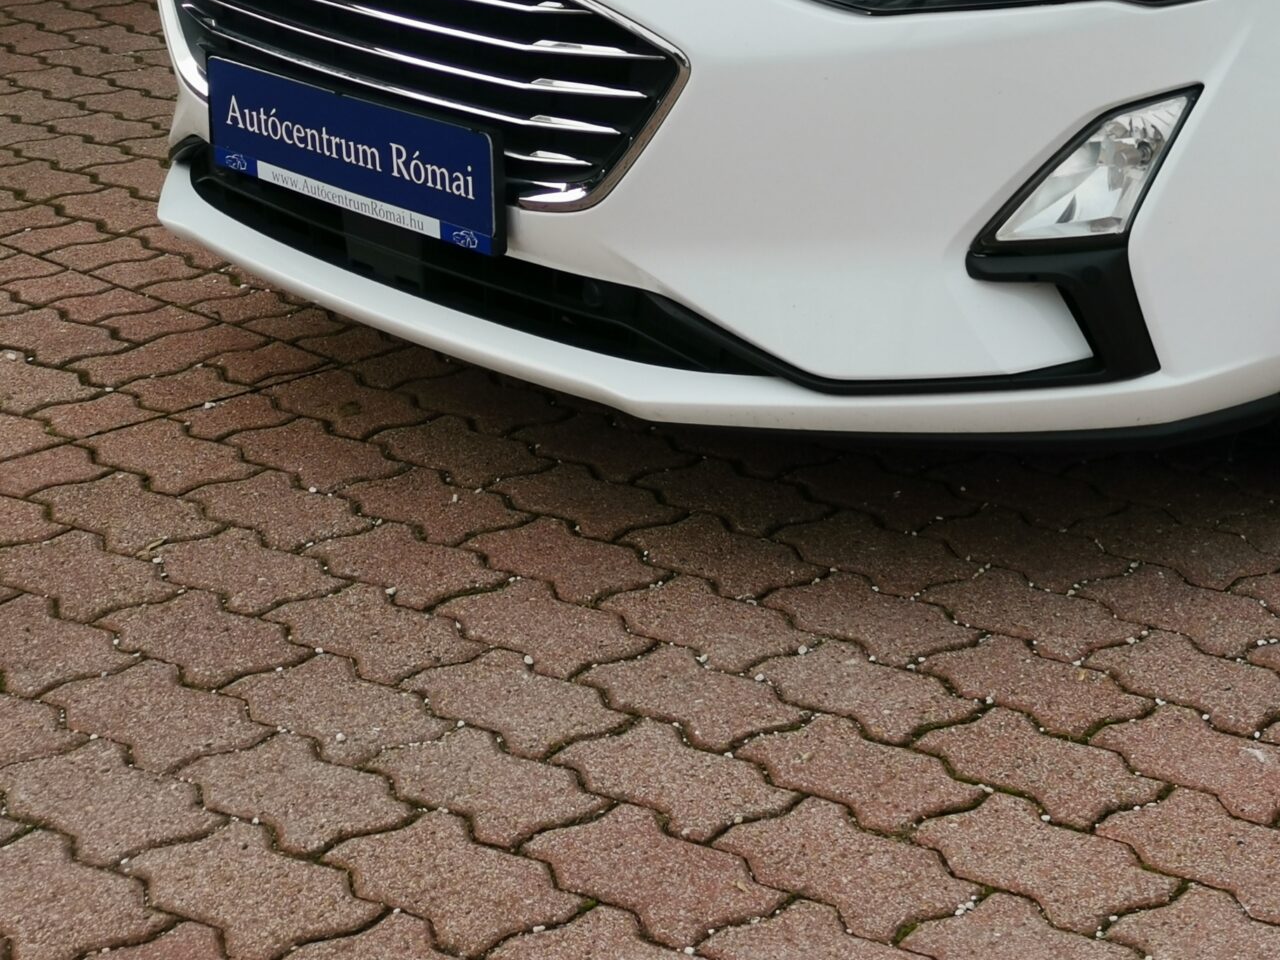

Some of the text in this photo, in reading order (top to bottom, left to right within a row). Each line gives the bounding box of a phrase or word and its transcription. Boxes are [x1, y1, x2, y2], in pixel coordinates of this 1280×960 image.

[226, 94, 475, 200] Autócentrum Római
[271, 170, 425, 231] www.AutócentrumRómai.hu
